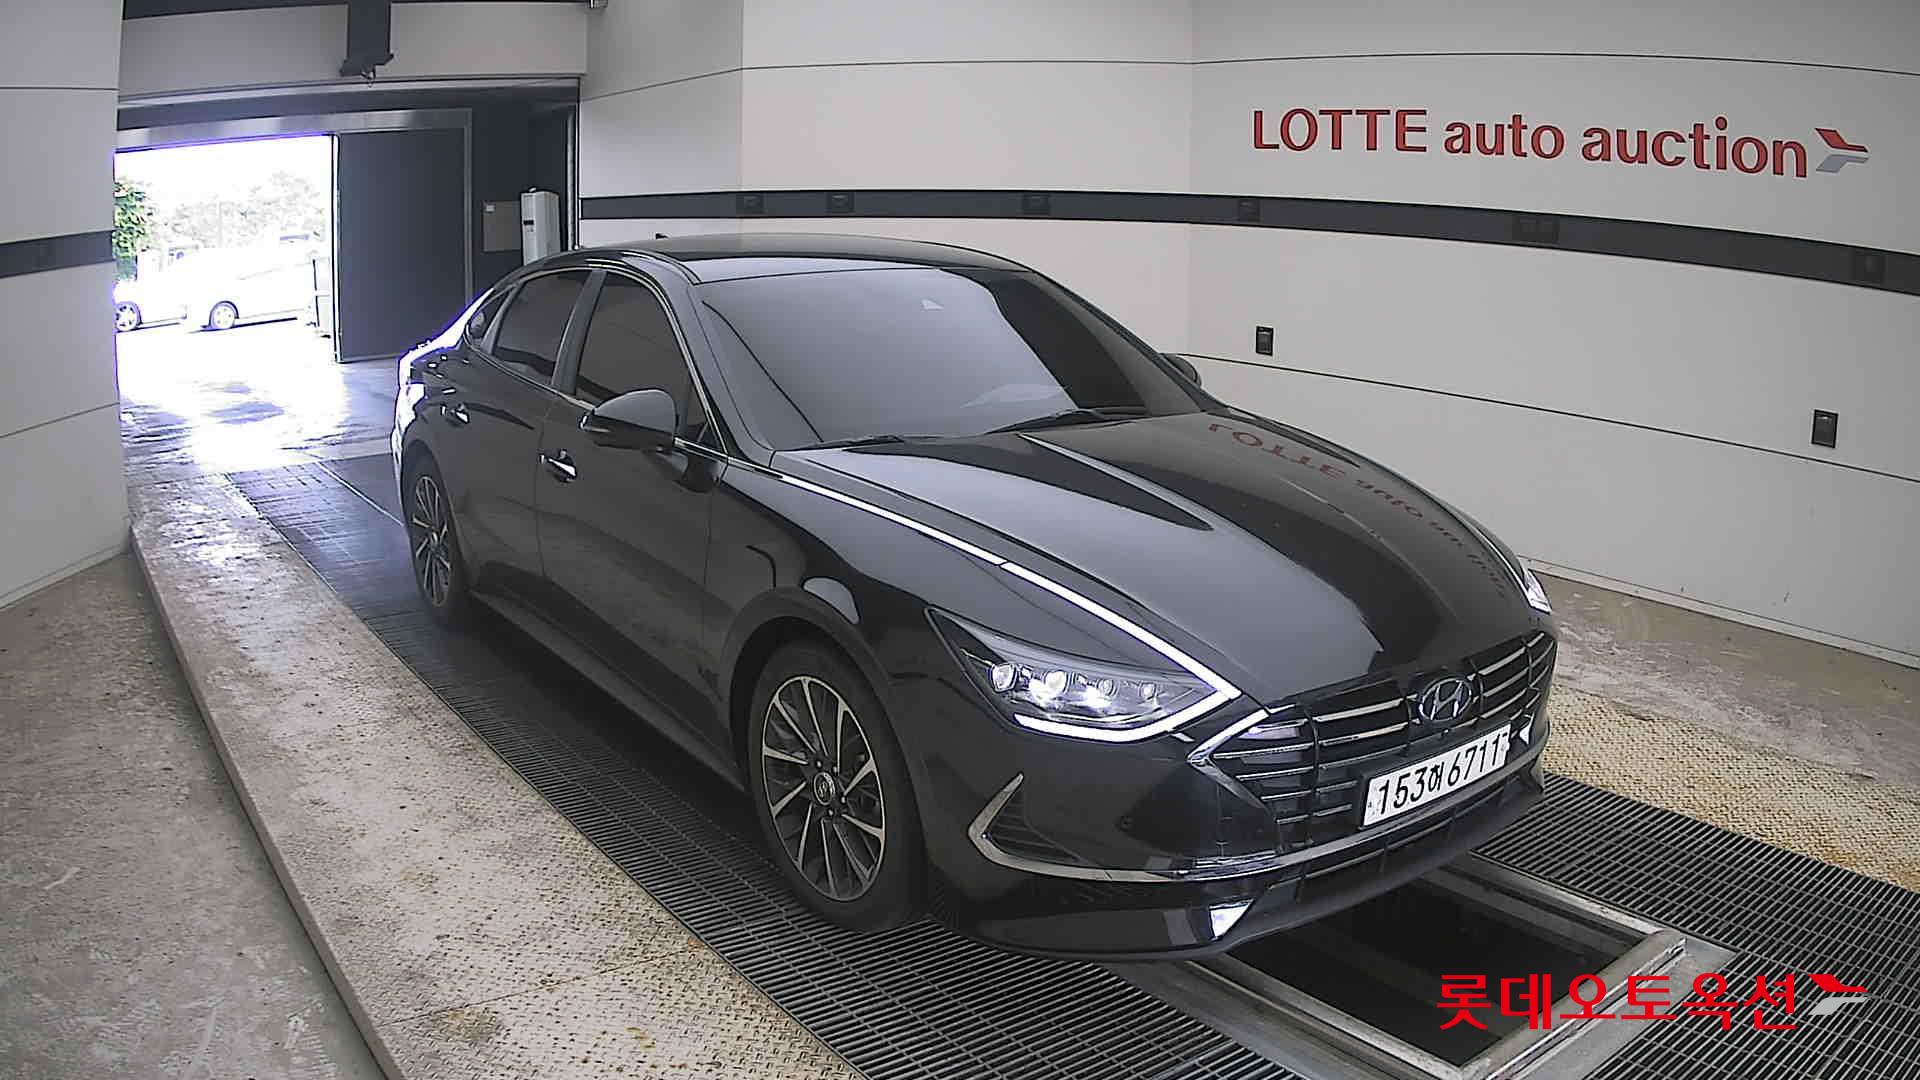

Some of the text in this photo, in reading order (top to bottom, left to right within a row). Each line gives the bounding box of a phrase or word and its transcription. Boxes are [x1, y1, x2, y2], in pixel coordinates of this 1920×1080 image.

[1253, 108, 1808, 179] LOTTE auto auction
